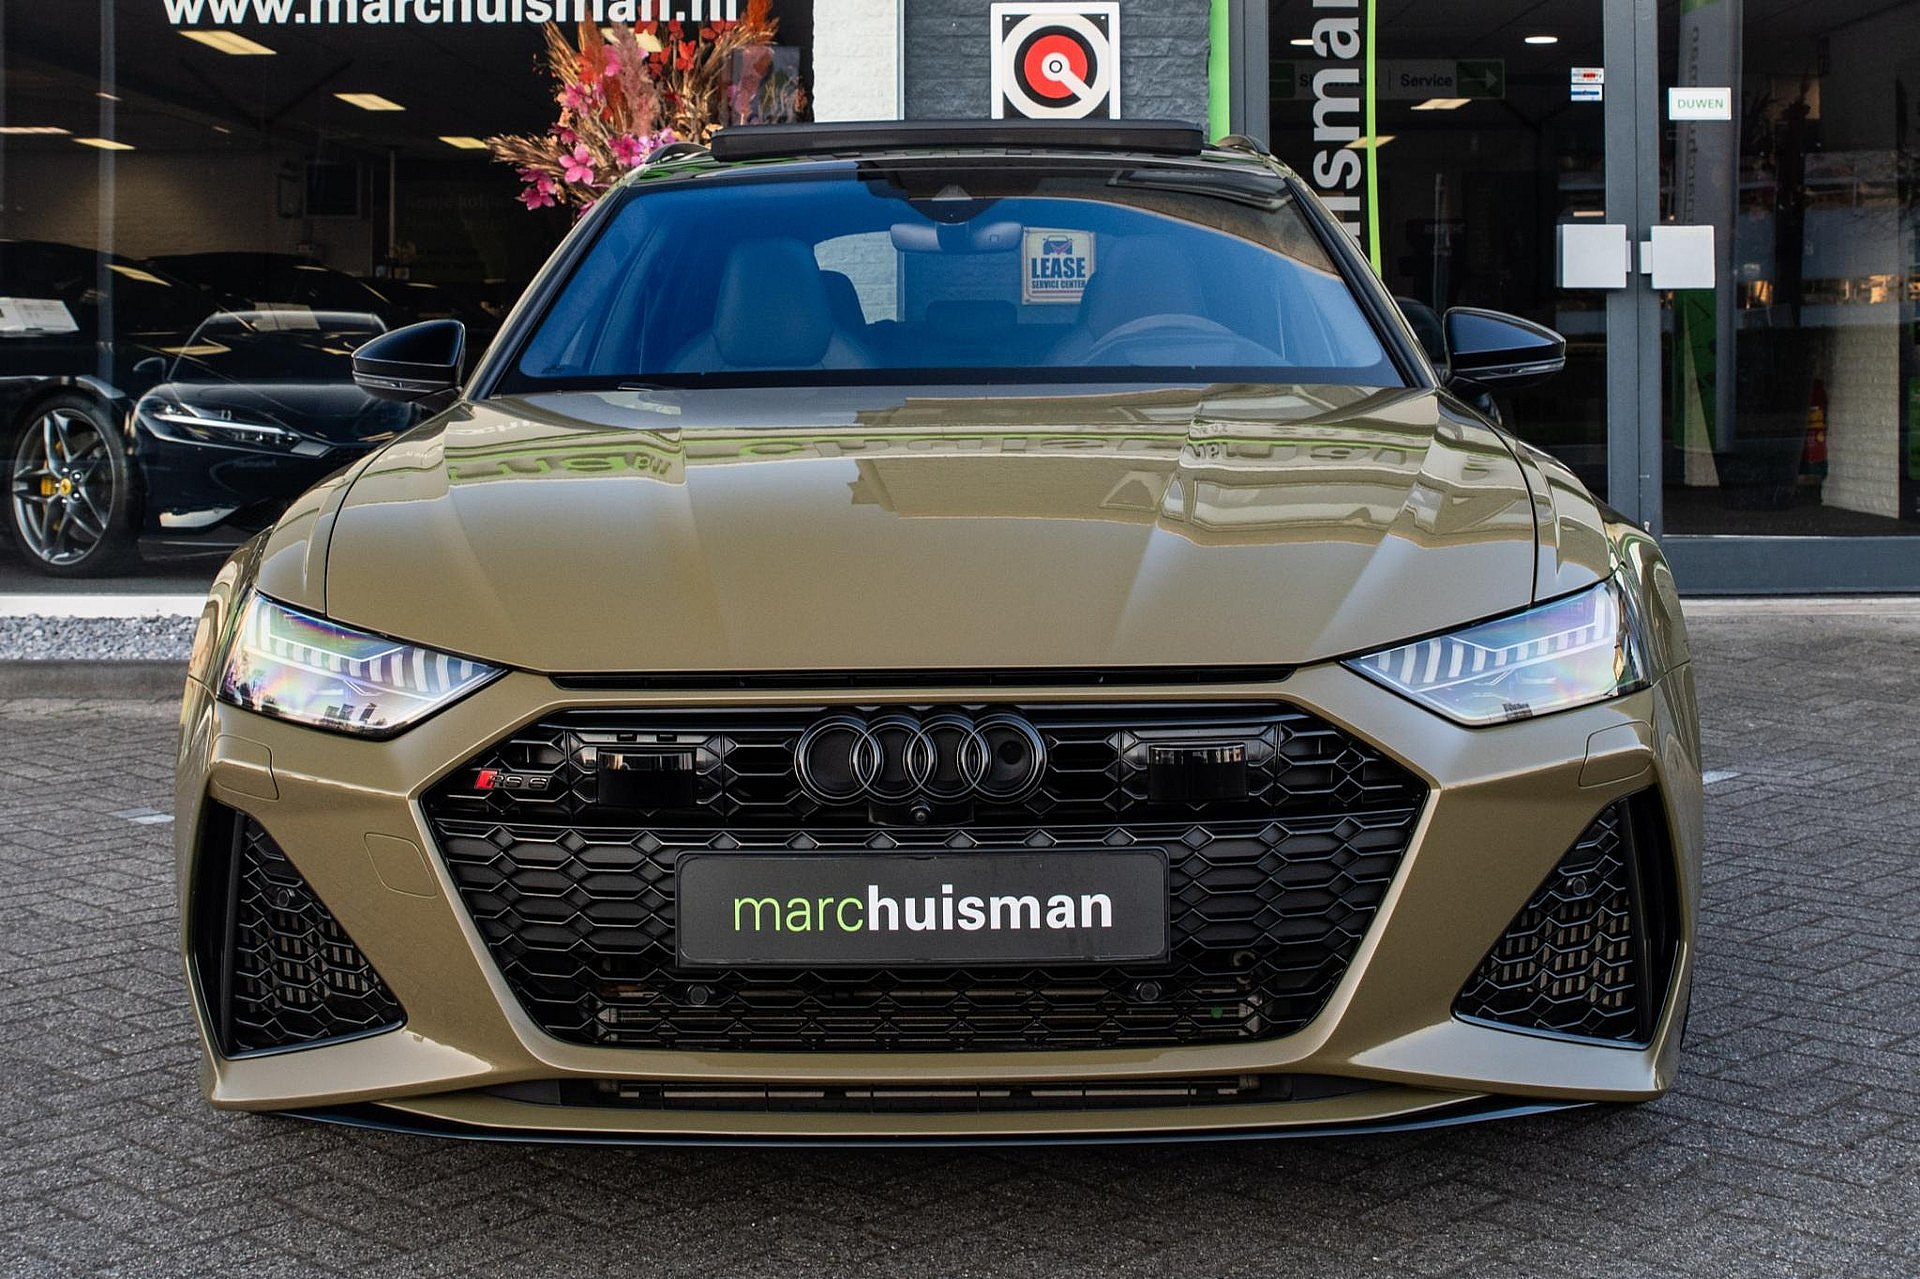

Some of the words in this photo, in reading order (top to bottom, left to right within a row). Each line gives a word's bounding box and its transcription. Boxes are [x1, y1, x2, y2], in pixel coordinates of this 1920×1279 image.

[1400, 73, 1453, 88] Service
[1677, 98, 1724, 109] DUWEN
[1031, 256, 1086, 279] LEASE
[1031, 280, 1059, 289] SERVICE
[733, 884, 1113, 932] marchuisman
